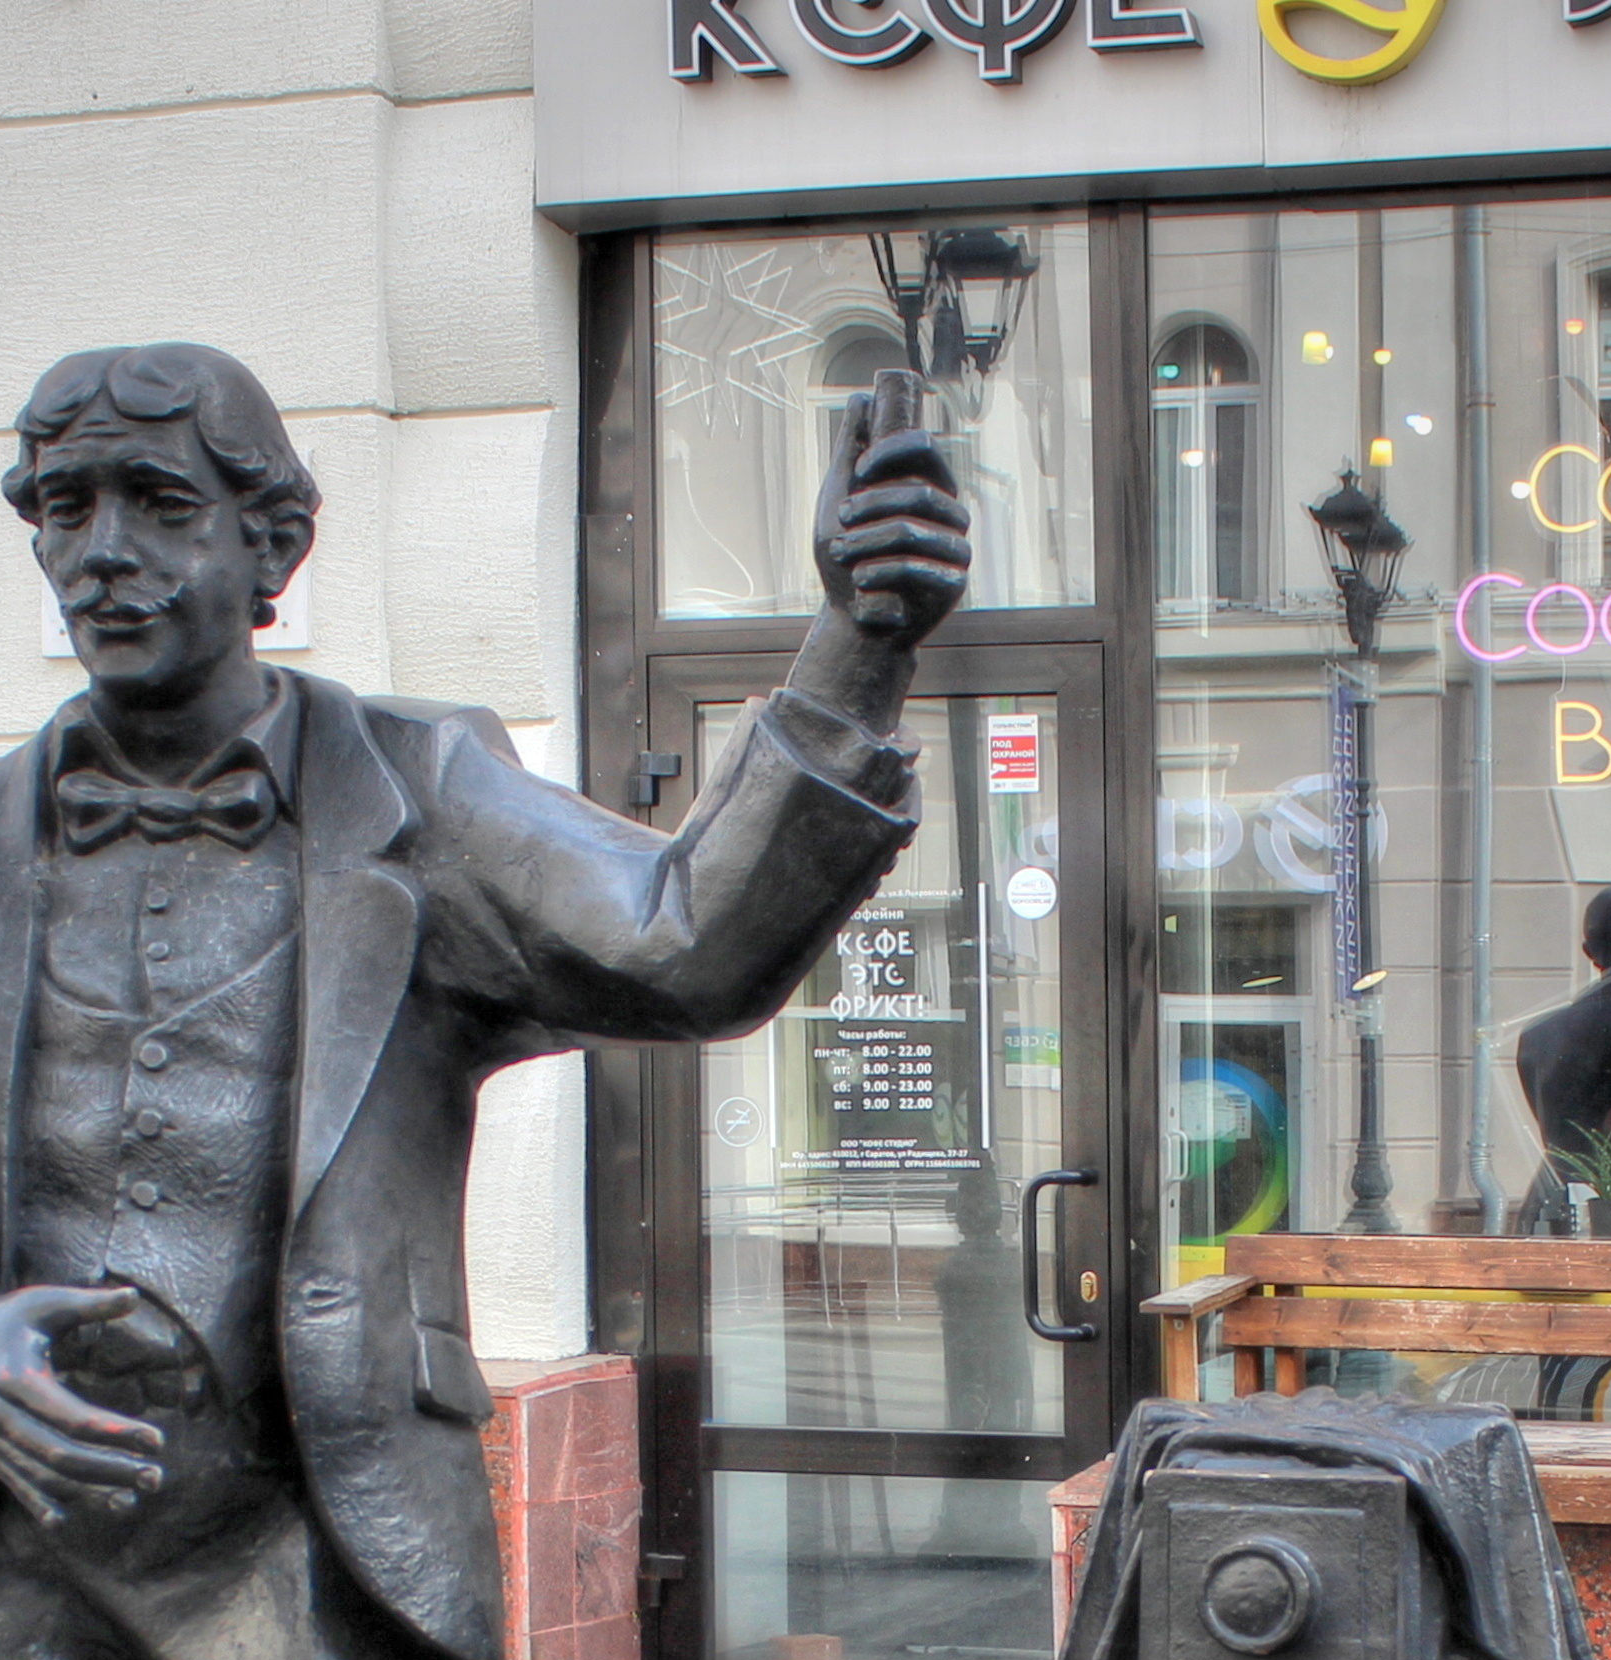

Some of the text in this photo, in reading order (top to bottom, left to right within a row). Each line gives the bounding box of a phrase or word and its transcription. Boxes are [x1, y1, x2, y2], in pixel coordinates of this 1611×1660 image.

[992, 740, 1012, 748] ПОД
[992, 749, 1035, 758] ОХРАНОЙ
[830, 992, 925, 1022] ФРУКТ!
[838, 1029, 907, 1040] Часы работы:
[814, 1048, 851, 1058] пн-чт:
[862, 1045, 889, 1057] 8.00
[898, 1045, 932, 1057] 22.00
[833, 1066, 851, 1075] пт:
[862, 1063, 889, 1075] 8.00
[898, 1063, 932, 1075] 23.00
[833, 1080, 851, 1093] сб:
[862, 1080, 889, 1093] 9.00
[898, 1080, 933, 1093] 23.00
[834, 1098, 933, 1110] вс: 9.00 22.00
[840, 1139, 858, 1147] ООО
